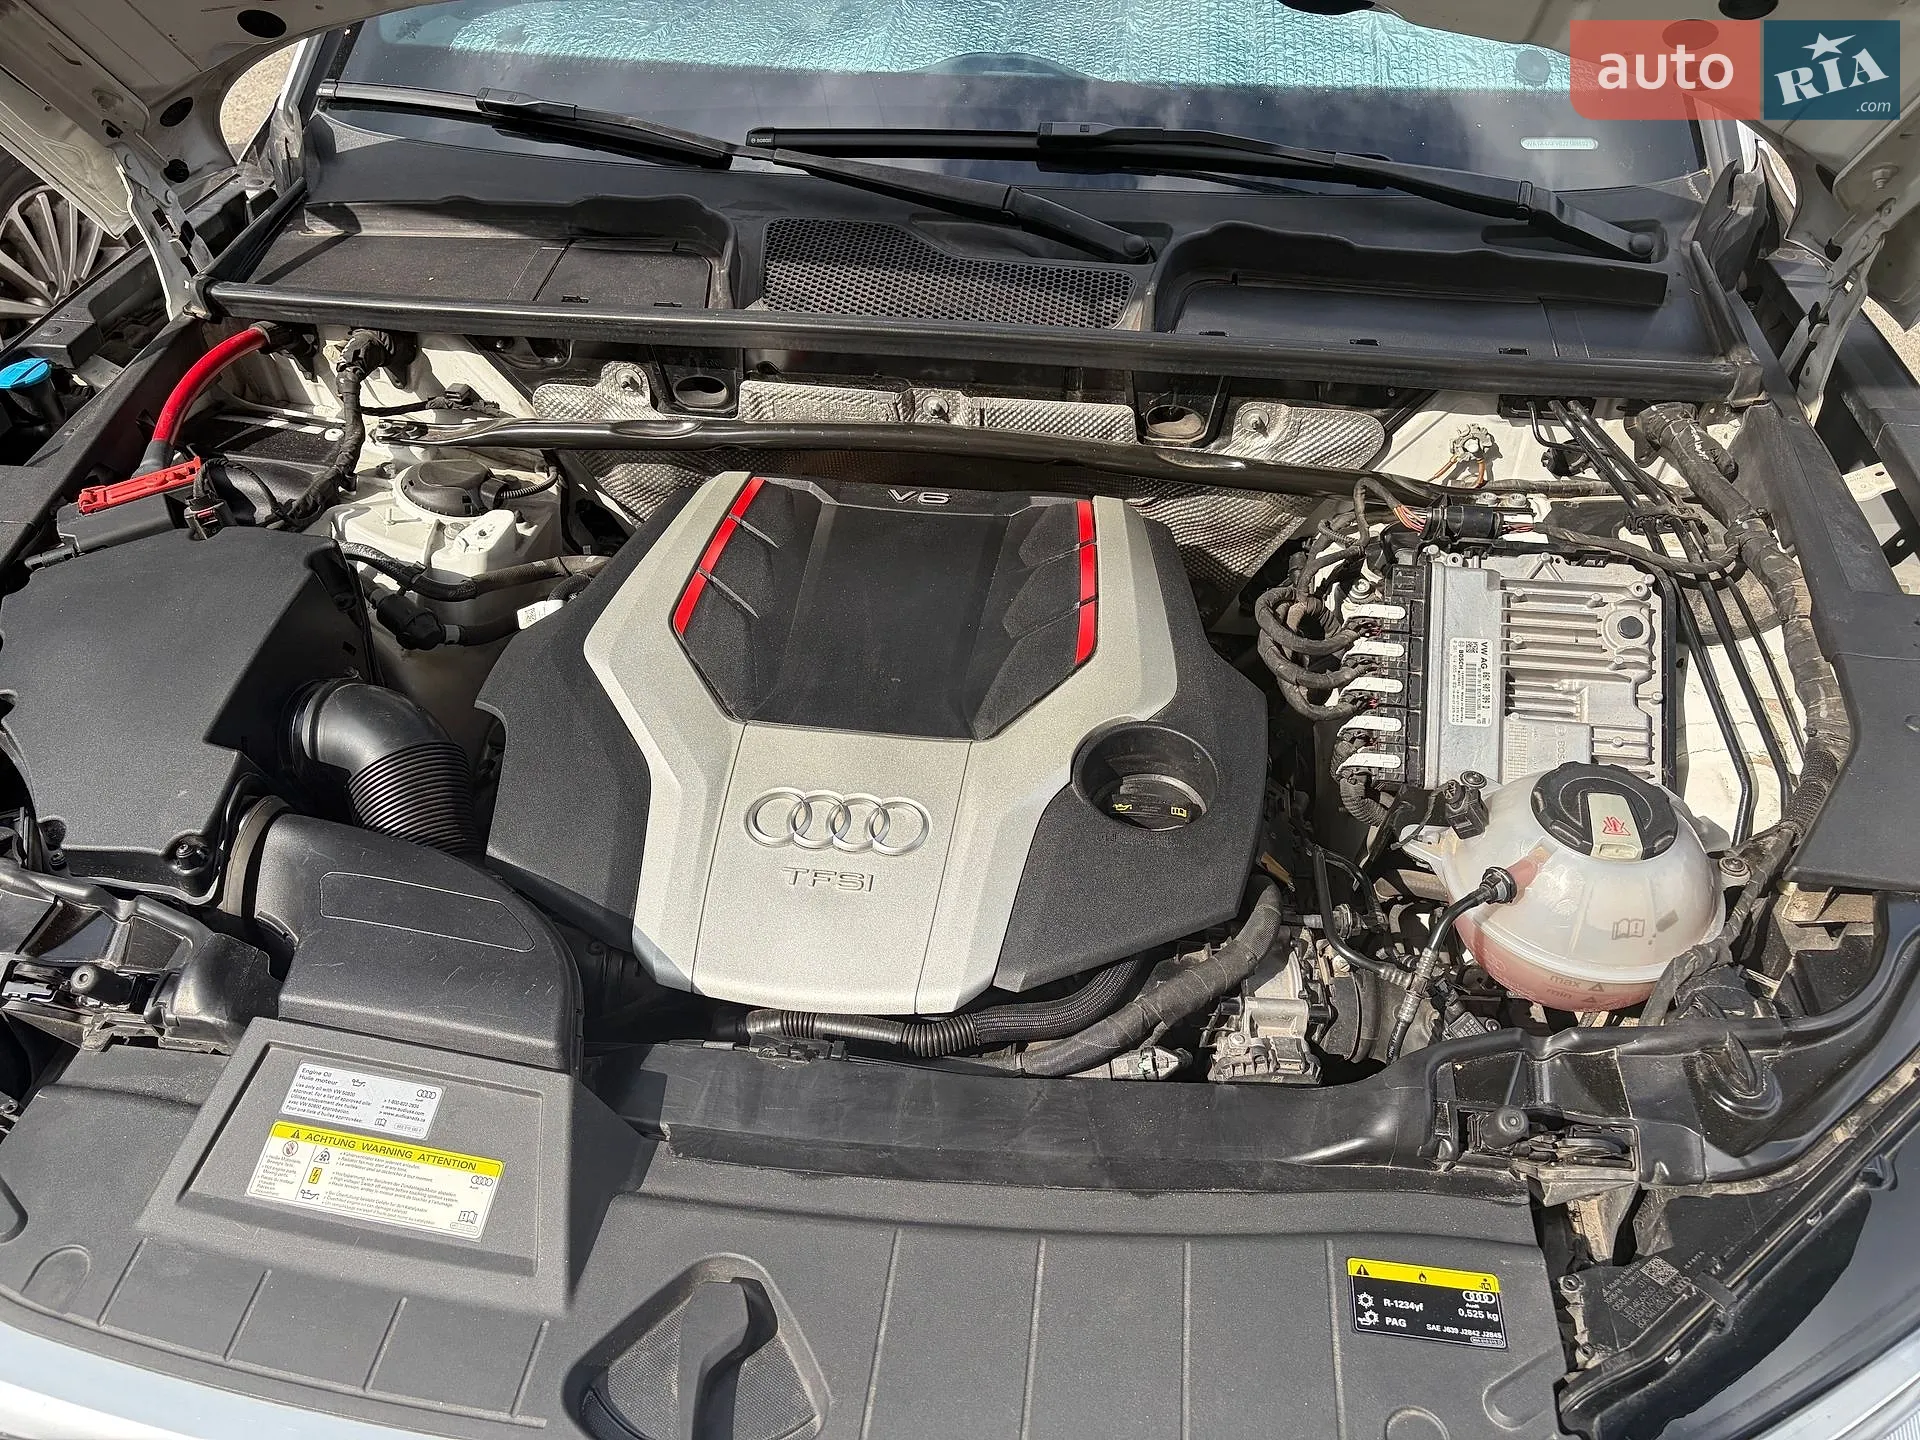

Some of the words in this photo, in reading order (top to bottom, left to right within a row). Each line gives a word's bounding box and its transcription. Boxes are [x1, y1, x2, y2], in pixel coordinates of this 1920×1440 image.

[888, 489, 950, 505] V6
[1480, 641, 1487, 655] VW
[1480, 657, 1487, 669] AG
[781, 866, 875, 893] TFSI
[1550, 975, 1581, 988] max
[300, 1067, 322, 1076] Engine
[314, 1077, 338, 1085] moteur
[304, 1132, 356, 1148] ACHTUNG
[359, 1142, 413, 1158] WARNING
[416, 1152, 477, 1170] ATTENTION
[1383, 1297, 1424, 1312] R-1234yf
[1384, 1316, 1407, 1327] PAG
[1457, 1308, 1485, 1319] 0,525
[1486, 1311, 1499, 1322] kg
[1425, 1323, 1441, 1332] SAE
